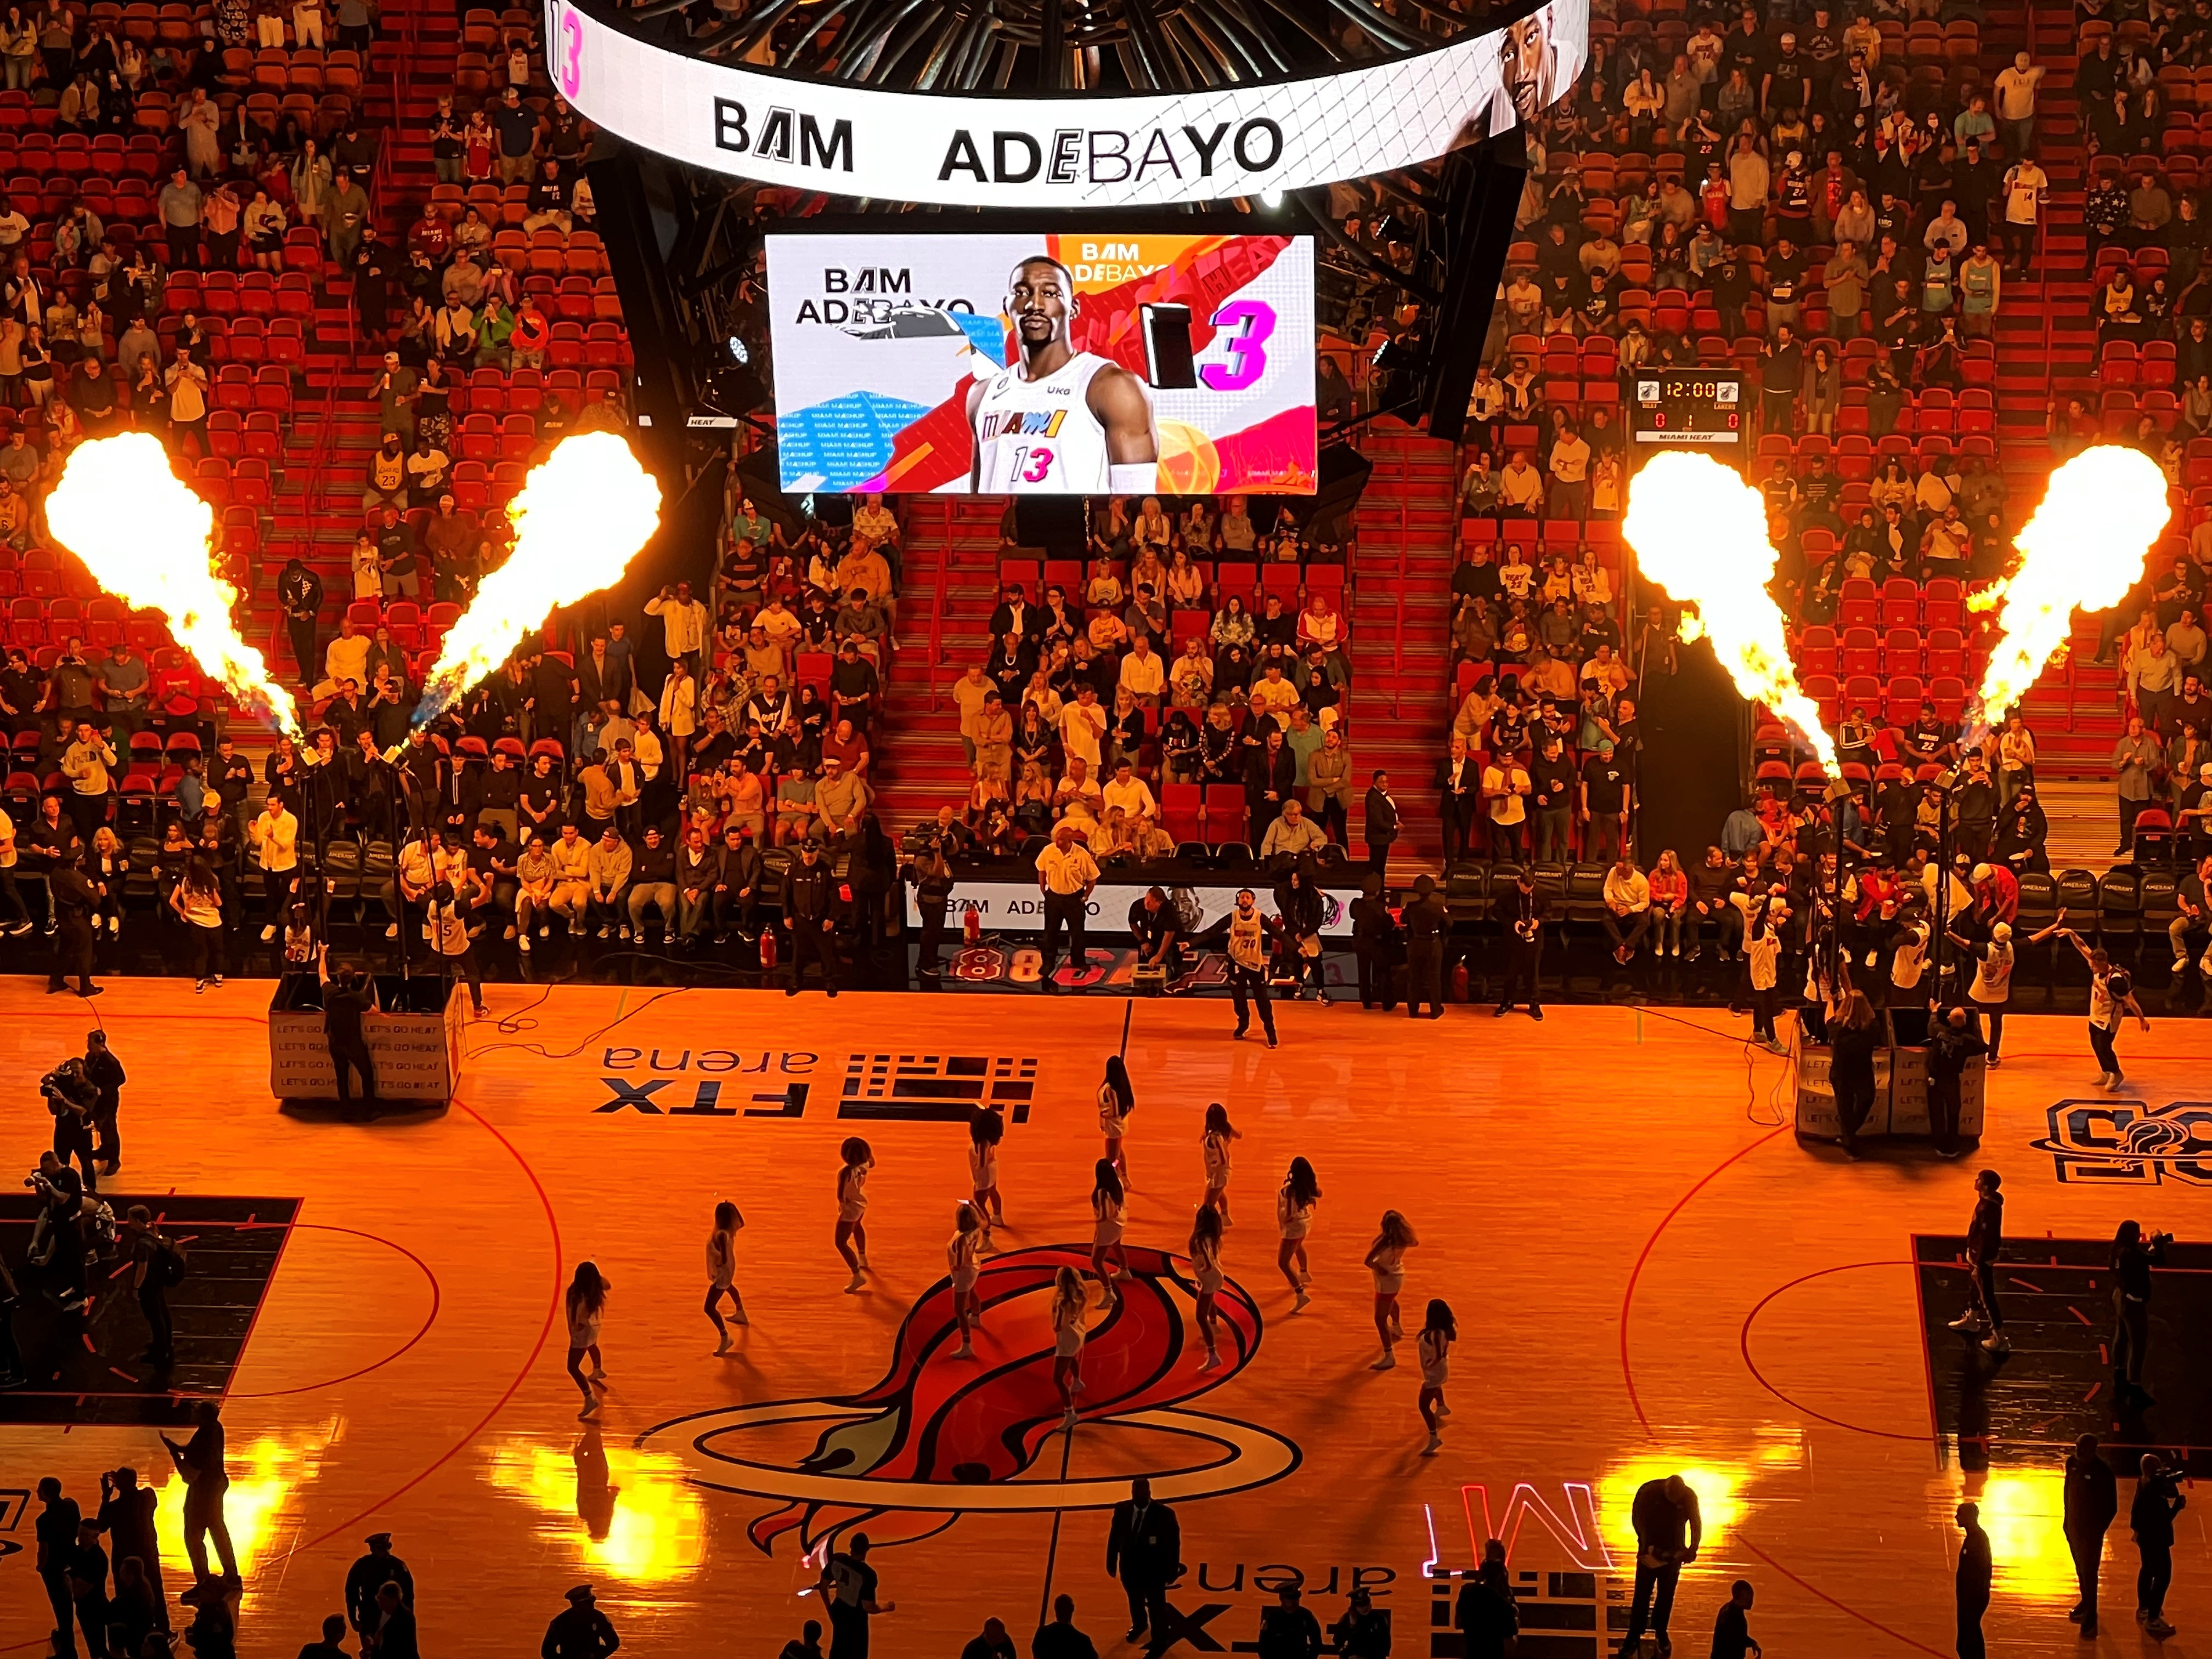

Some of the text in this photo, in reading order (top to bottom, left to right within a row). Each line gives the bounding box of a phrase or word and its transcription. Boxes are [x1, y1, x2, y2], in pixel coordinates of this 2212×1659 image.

[713, 95, 1283, 184] BAM ADEBAYO
[1700, 145, 1712, 154] 22
[1082, 242, 1139, 262] BAM
[1065, 263, 1169, 282] ADEBAY
[825, 267, 911, 294] BAM
[1139, 299, 1278, 391] 13
[1667, 382, 1715, 398] 12:00
[1655, 413, 1666, 428] 0
[1688, 415, 1692, 427] 1
[1729, 414, 1739, 429] 0
[1011, 446, 1054, 482] 13
[382, 476, 396, 486] 23
[1510, 580, 1522, 589] 22
[1921, 741, 1935, 751] 22
[329, 851, 356, 860] AMERANT
[2104, 884, 2134, 892] AMERANT
[1243, 939, 1256, 949] 30
[307, 1025, 321, 1034] GO
[364, 1025, 437, 1035] LET'S GO HEAT
[278, 1042, 323, 1051] LET'S GO
[394, 1043, 409, 1052] GO
[411, 1044, 438, 1052] HEAT
[279, 1060, 306, 1069] LET'S
[374, 1061, 439, 1070] ET'S GO HEAT
[602, 1047, 819, 1074] arena
[281, 1078, 307, 1086] LET'S
[309, 1078, 325, 1086] GO
[590, 1077, 810, 1118] FTX
